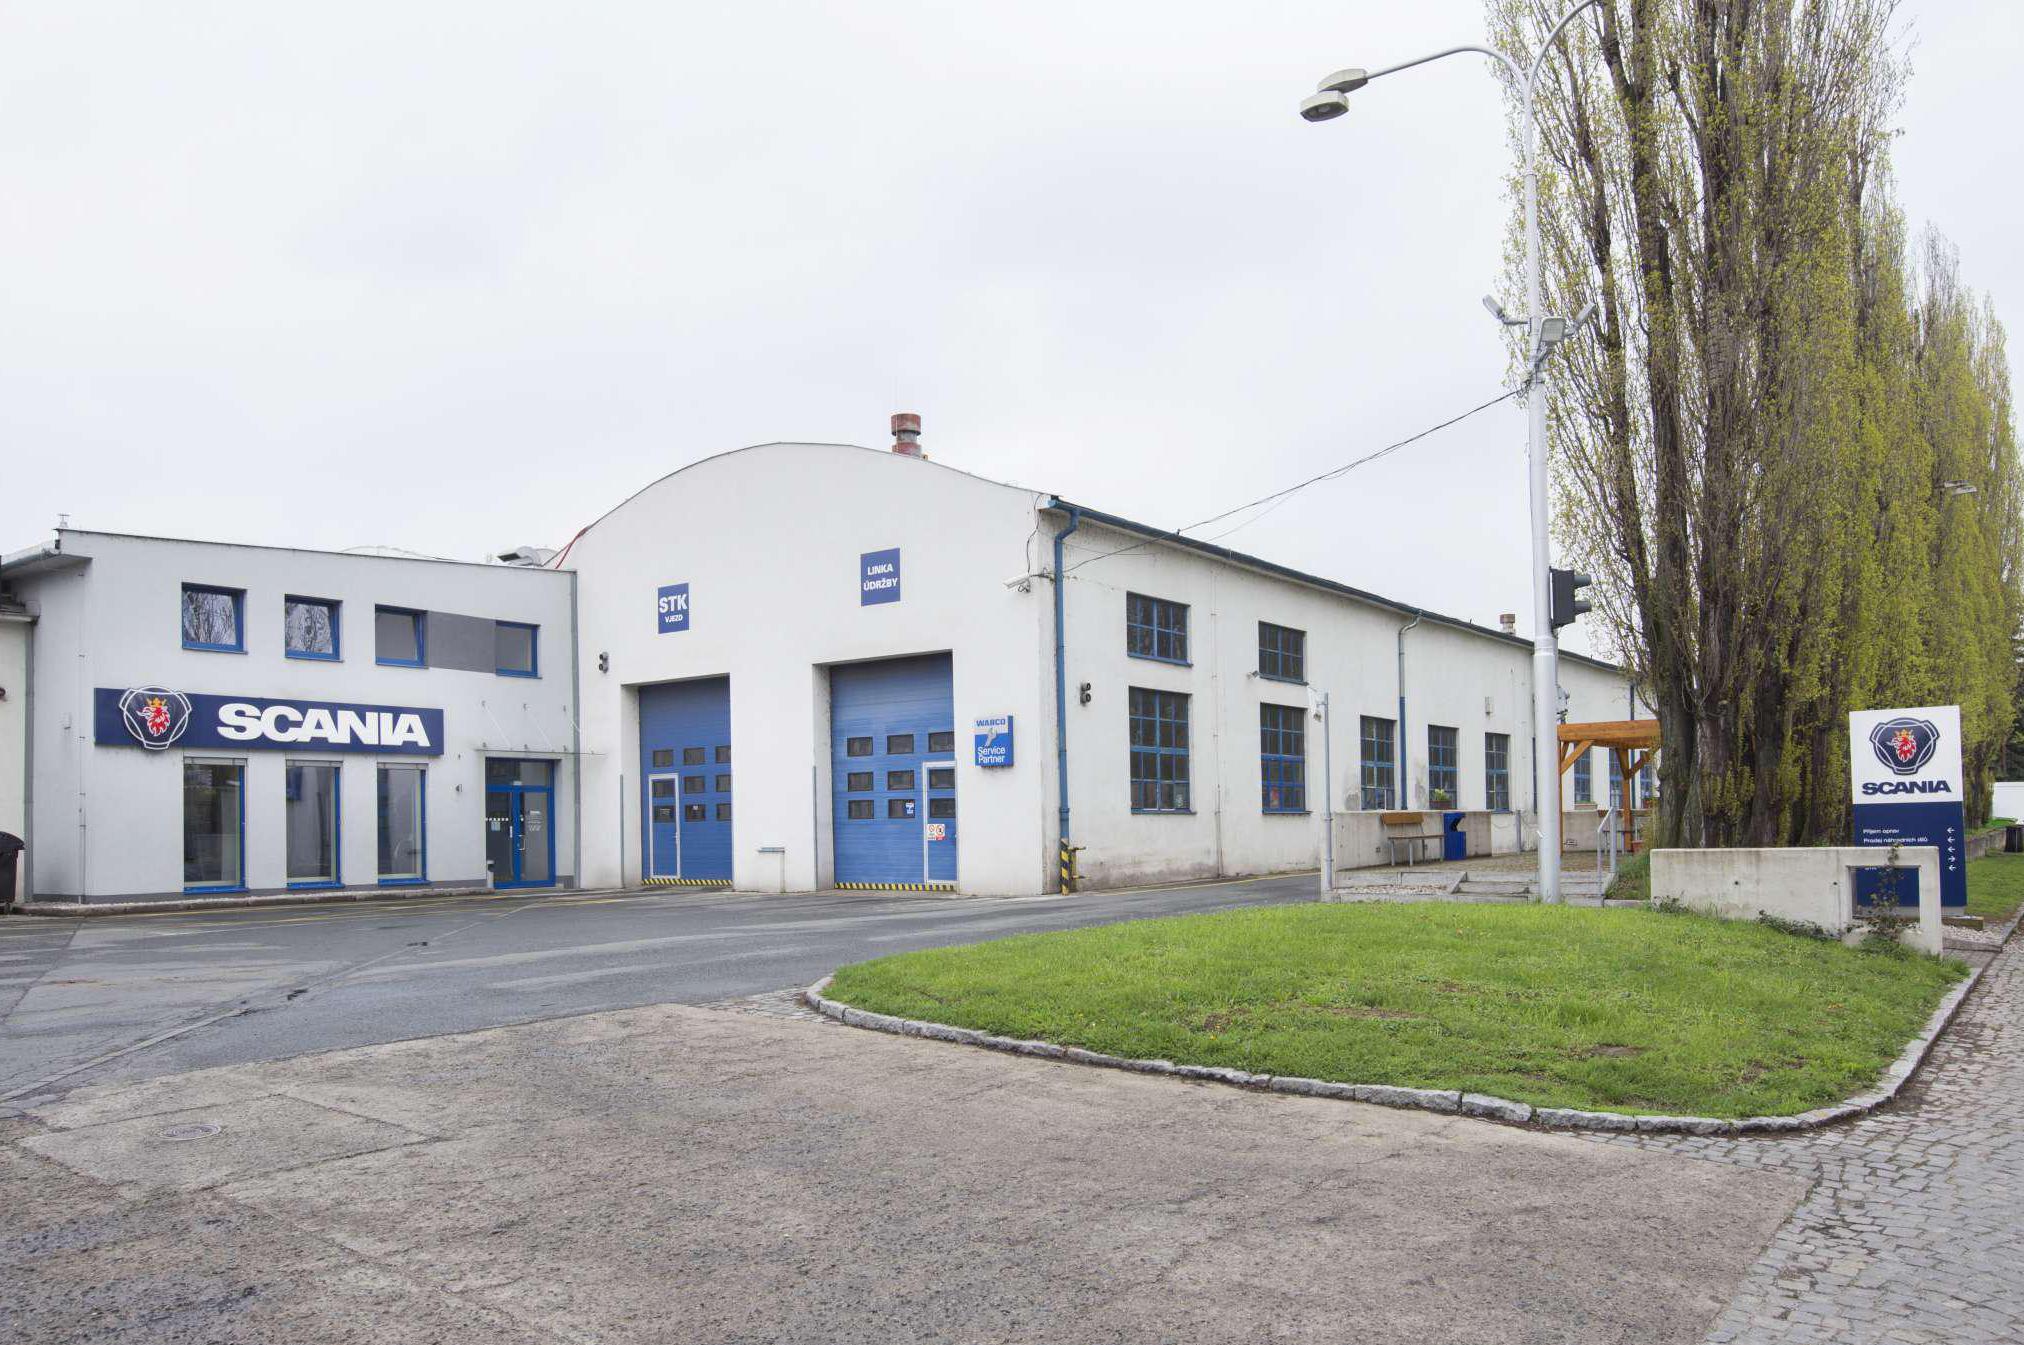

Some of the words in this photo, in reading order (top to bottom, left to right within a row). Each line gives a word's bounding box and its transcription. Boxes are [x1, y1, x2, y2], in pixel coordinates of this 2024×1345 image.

[867, 563, 893, 575] LINKA
[863, 577, 897, 591] ÚDRŽBY
[659, 594, 688, 613] STK
[216, 702, 431, 747] SCANIA
[977, 746, 1005, 755] Service
[978, 755, 1005, 764] Partner
[1862, 780, 1951, 795] SCANIA
